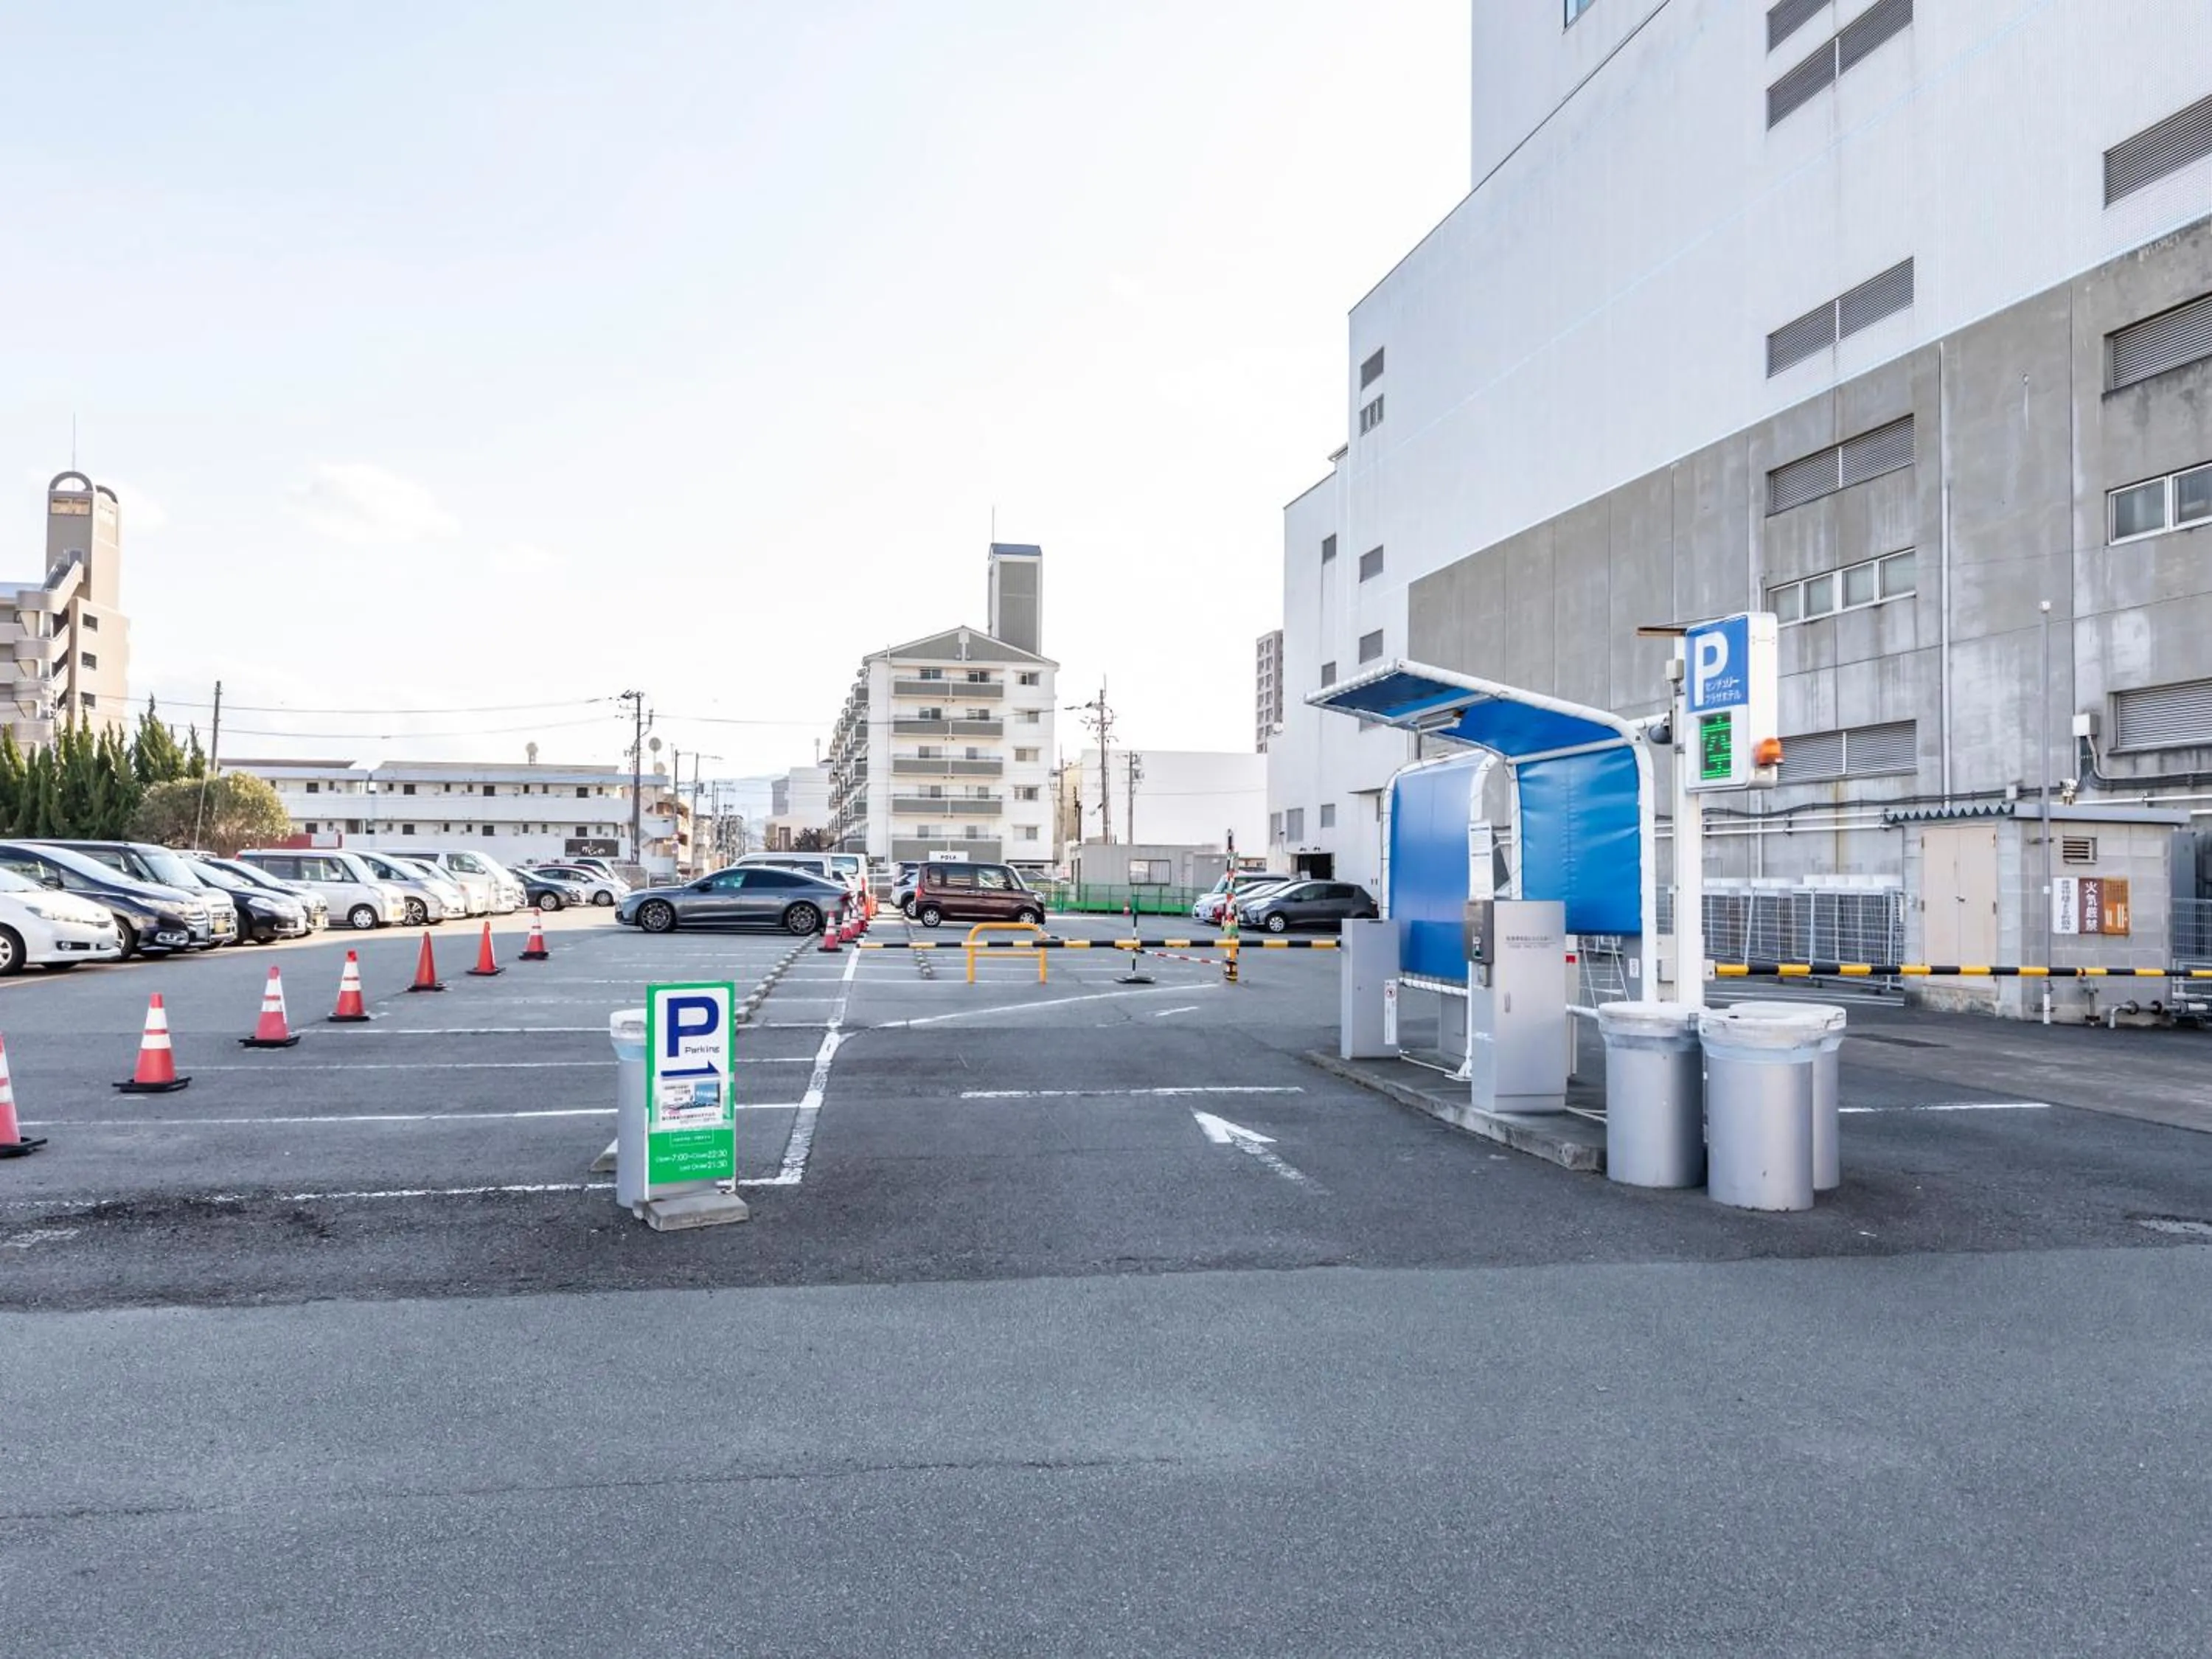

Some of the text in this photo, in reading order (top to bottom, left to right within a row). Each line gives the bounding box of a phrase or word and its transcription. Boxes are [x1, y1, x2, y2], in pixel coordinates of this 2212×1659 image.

[1694, 631, 1728, 706] P
[667, 996, 719, 1057] P
[684, 1046, 720, 1054] Parking
